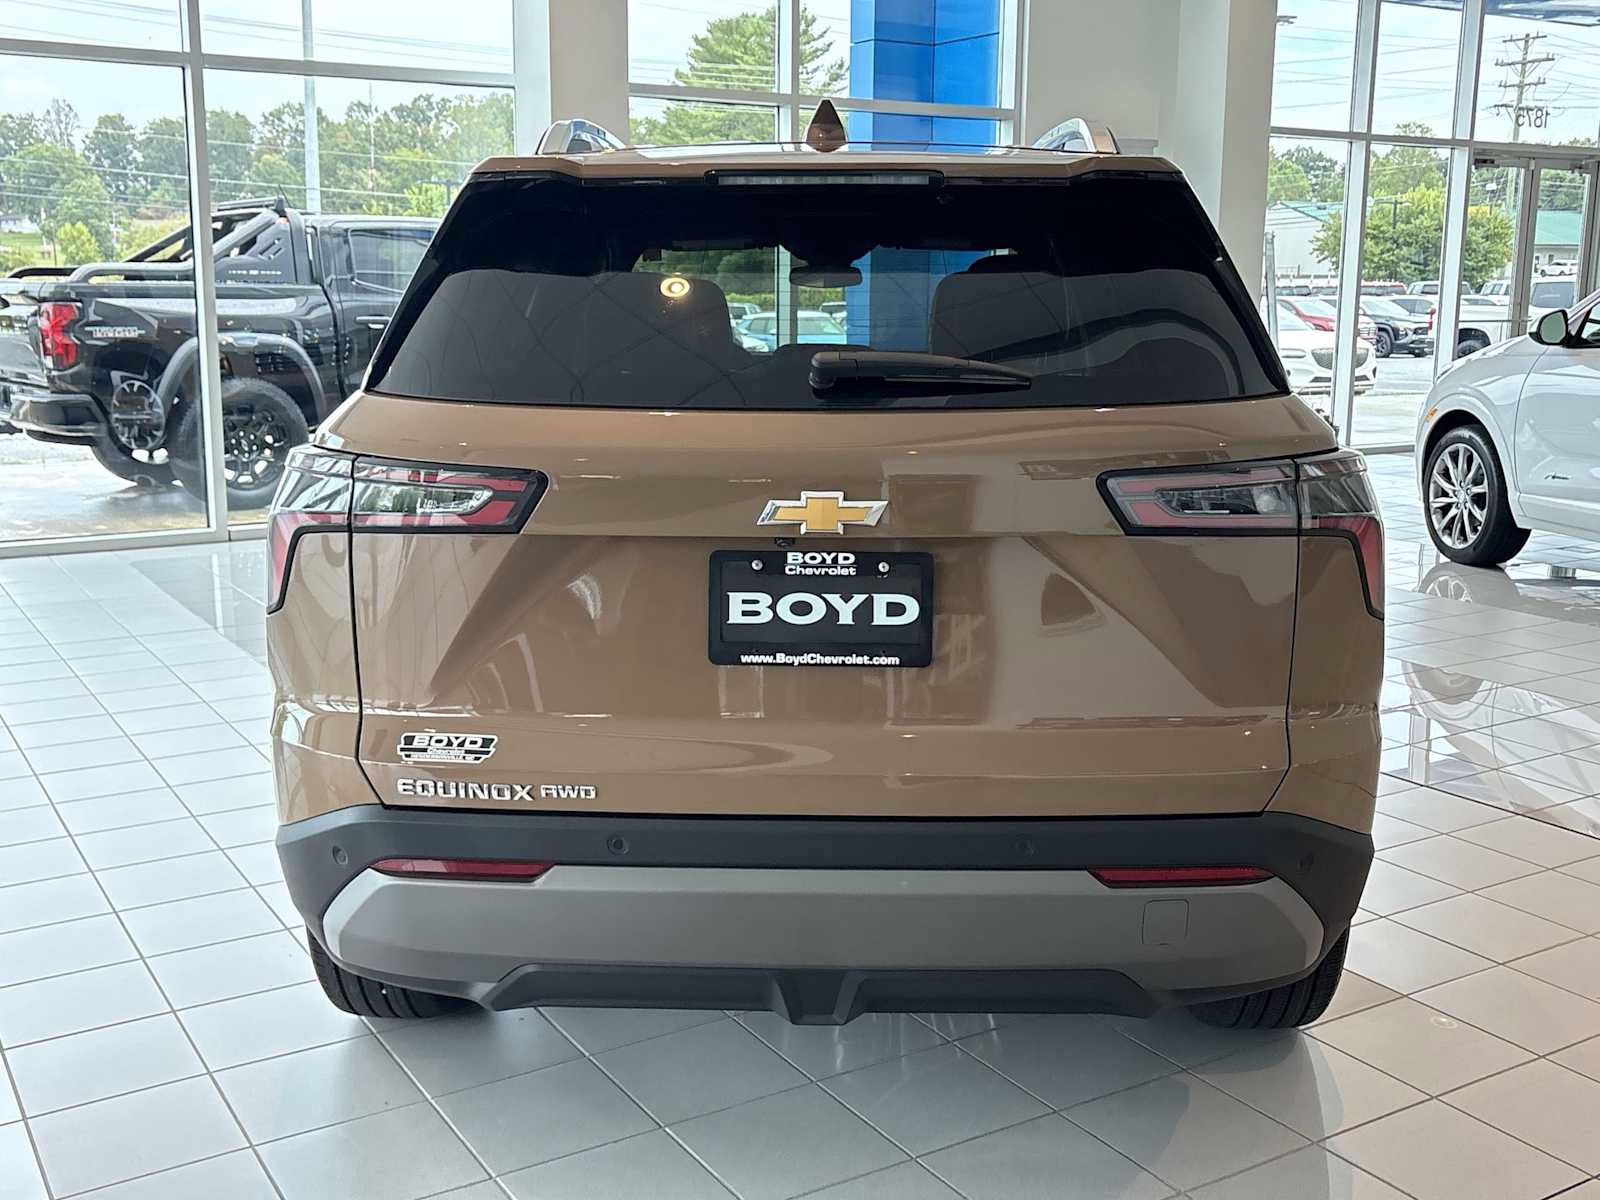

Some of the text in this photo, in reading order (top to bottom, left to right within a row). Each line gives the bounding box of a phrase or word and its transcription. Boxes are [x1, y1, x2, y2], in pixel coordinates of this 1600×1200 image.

[786, 552, 856, 565] BOYD
[785, 565, 857, 576] Chevrolet
[726, 592, 920, 626] BOYD
[740, 652, 900, 667] www.BoydChevrolet.com
[412, 735, 484, 748] BOYD
[397, 779, 598, 801] EQUINOX AWD
